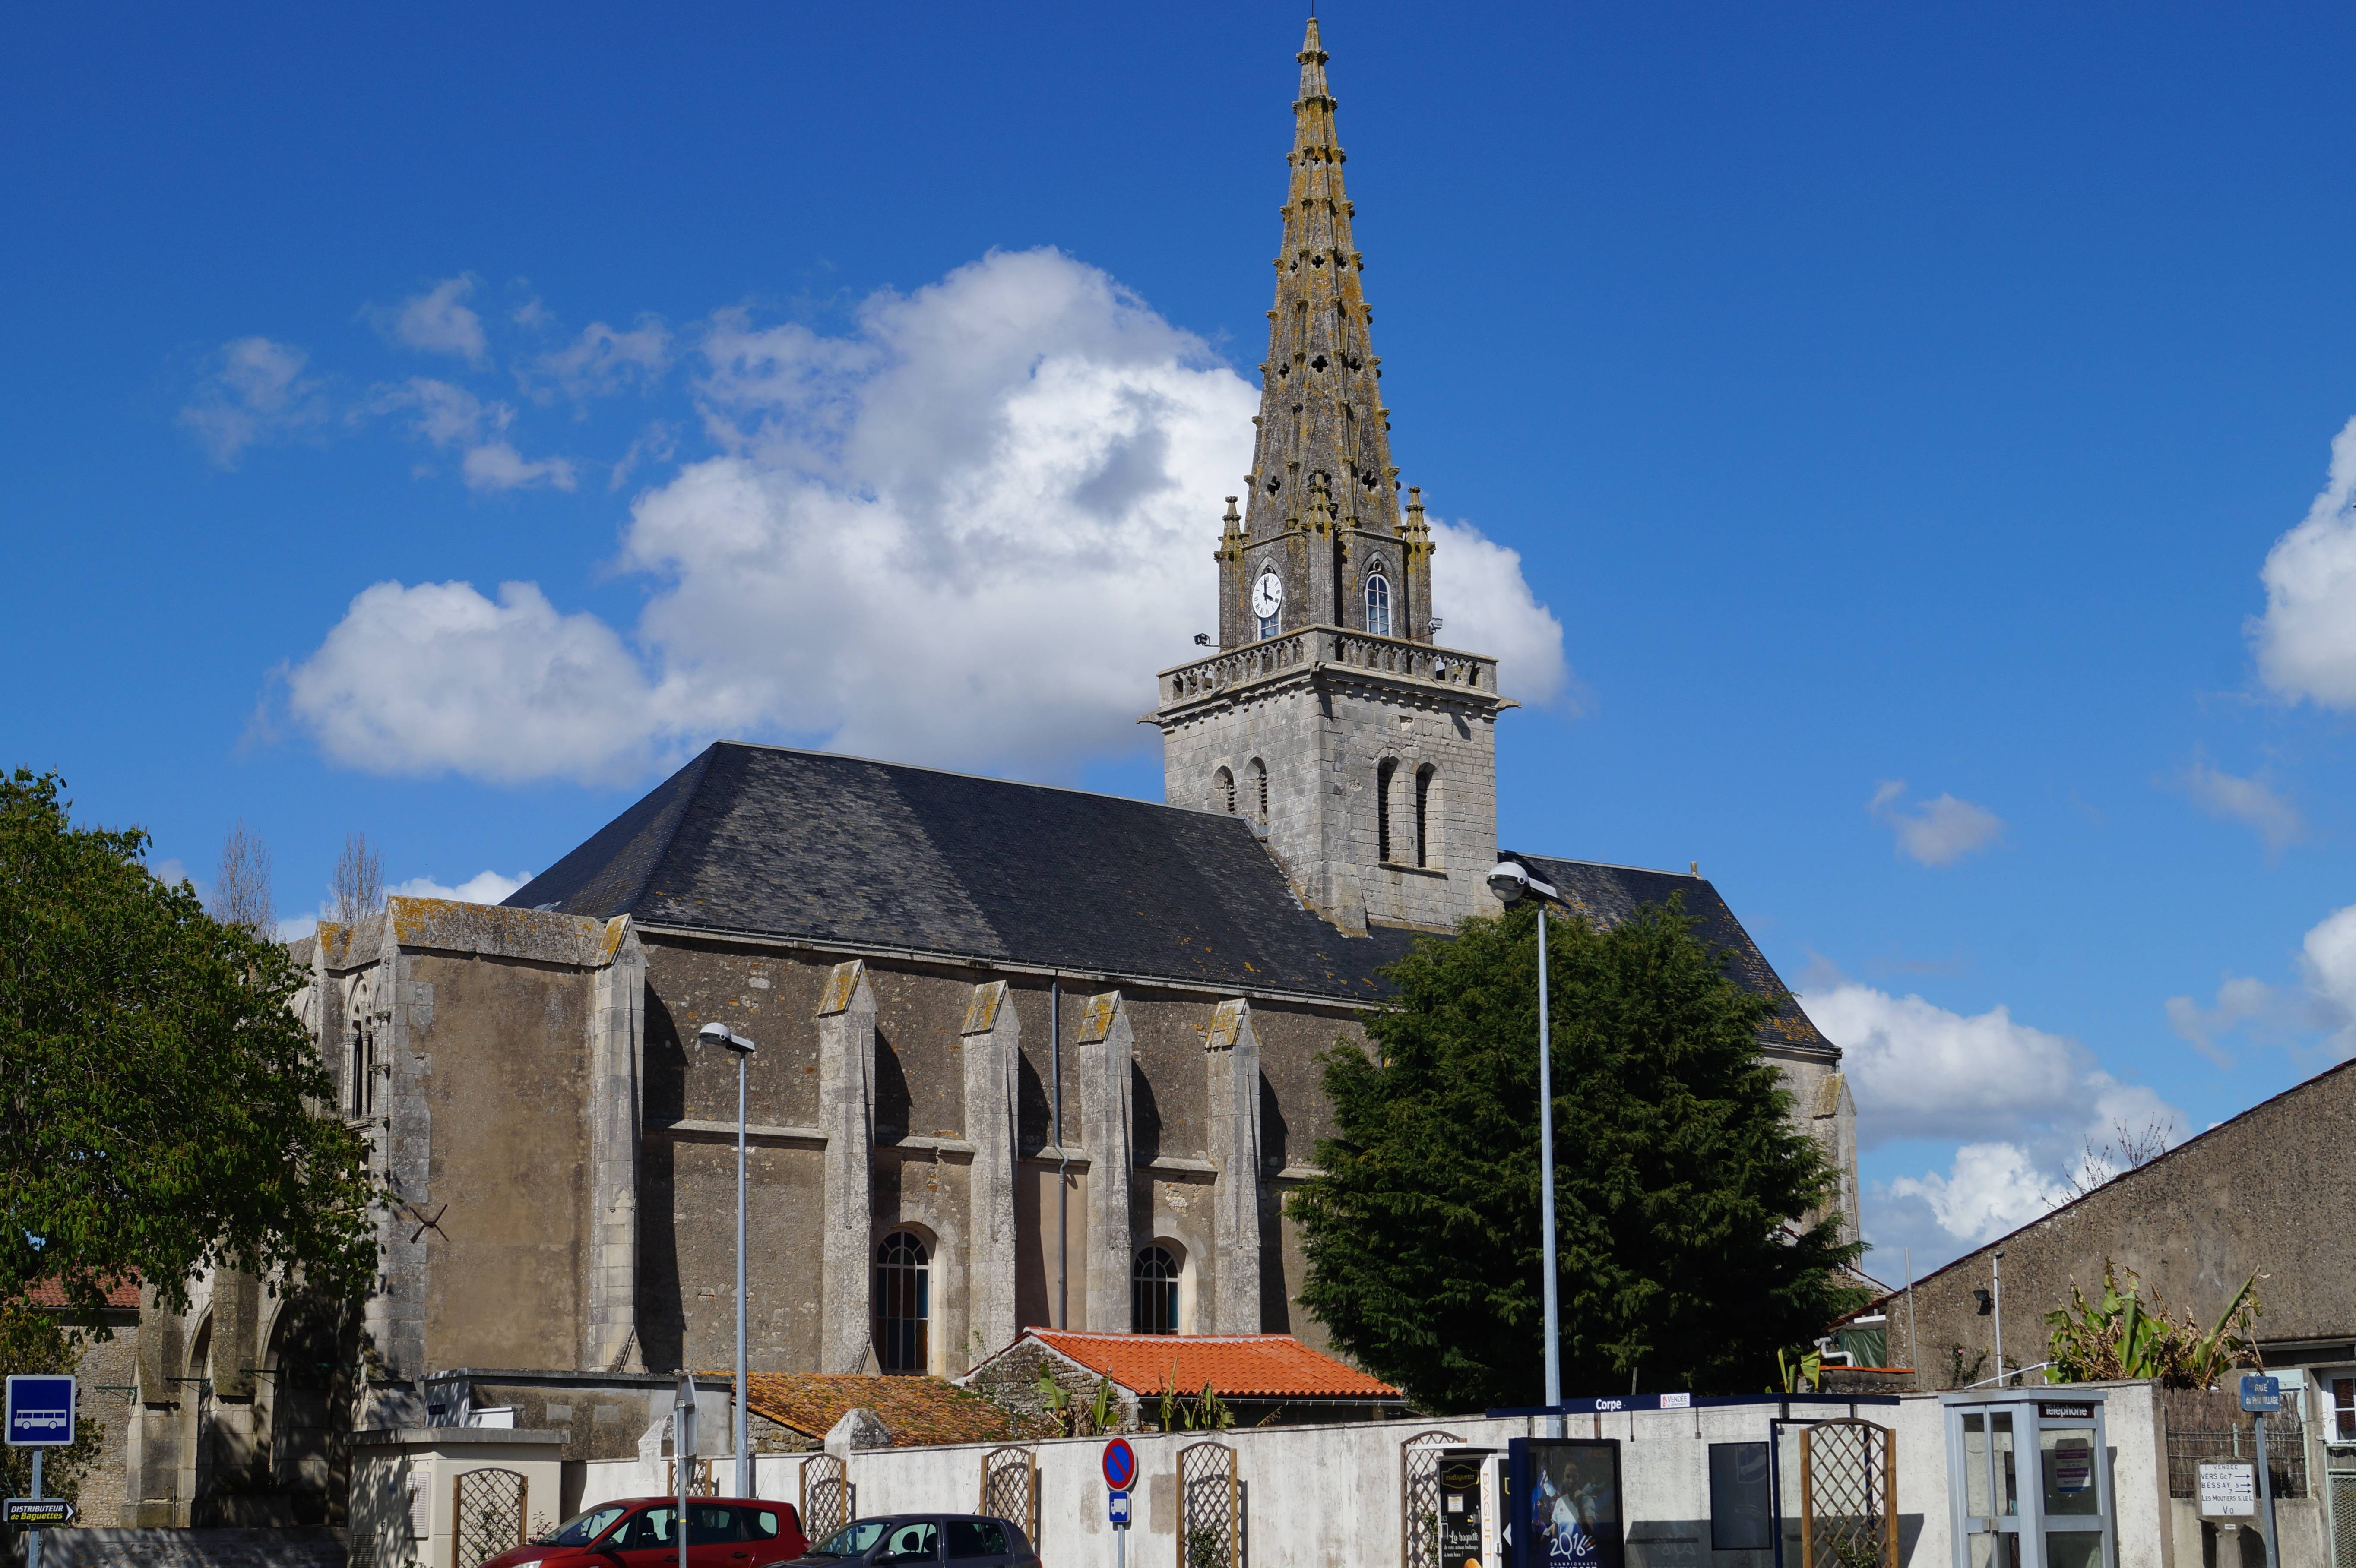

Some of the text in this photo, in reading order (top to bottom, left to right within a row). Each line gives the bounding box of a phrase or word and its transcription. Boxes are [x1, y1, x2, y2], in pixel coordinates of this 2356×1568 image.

[2255, 1383, 2268, 1392] RUE
[1667, 1394, 1687, 1403] VENDÉE
[1596, 1398, 1622, 1412] Corpe
[2044, 1404, 2087, 1417] Téléphone
[21, 1512, 63, 1521] Baguettes
[1449, 1529, 1479, 1545] La baguette
